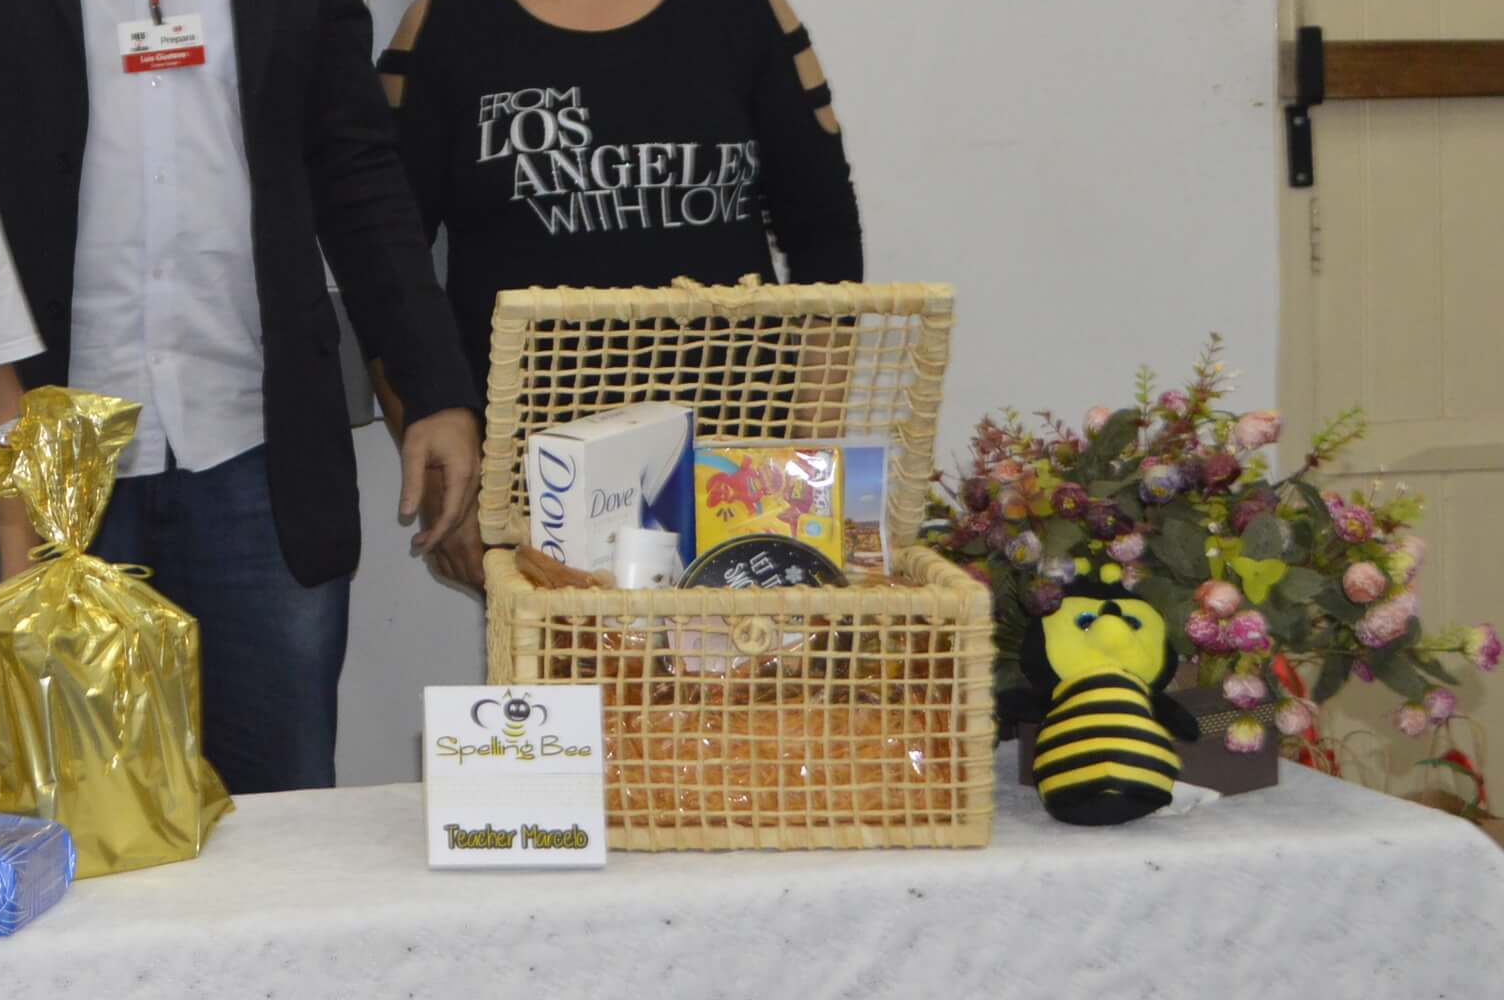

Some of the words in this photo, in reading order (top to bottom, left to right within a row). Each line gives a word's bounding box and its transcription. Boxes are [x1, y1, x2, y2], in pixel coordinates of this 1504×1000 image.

[479, 86, 581, 122] FROM
[476, 107, 592, 162] LOS
[510, 139, 760, 200] ANGELES
[526, 188, 651, 235] WITH
[659, 185, 752, 228] LOVE
[539, 446, 577, 565] Dove
[590, 487, 635, 519] Dove
[749, 550, 775, 575] LET
[435, 734, 536, 765] Spelling
[540, 734, 593, 757] Bee
[444, 823, 518, 850] Teacher
[520, 823, 589, 850] Marcelo
